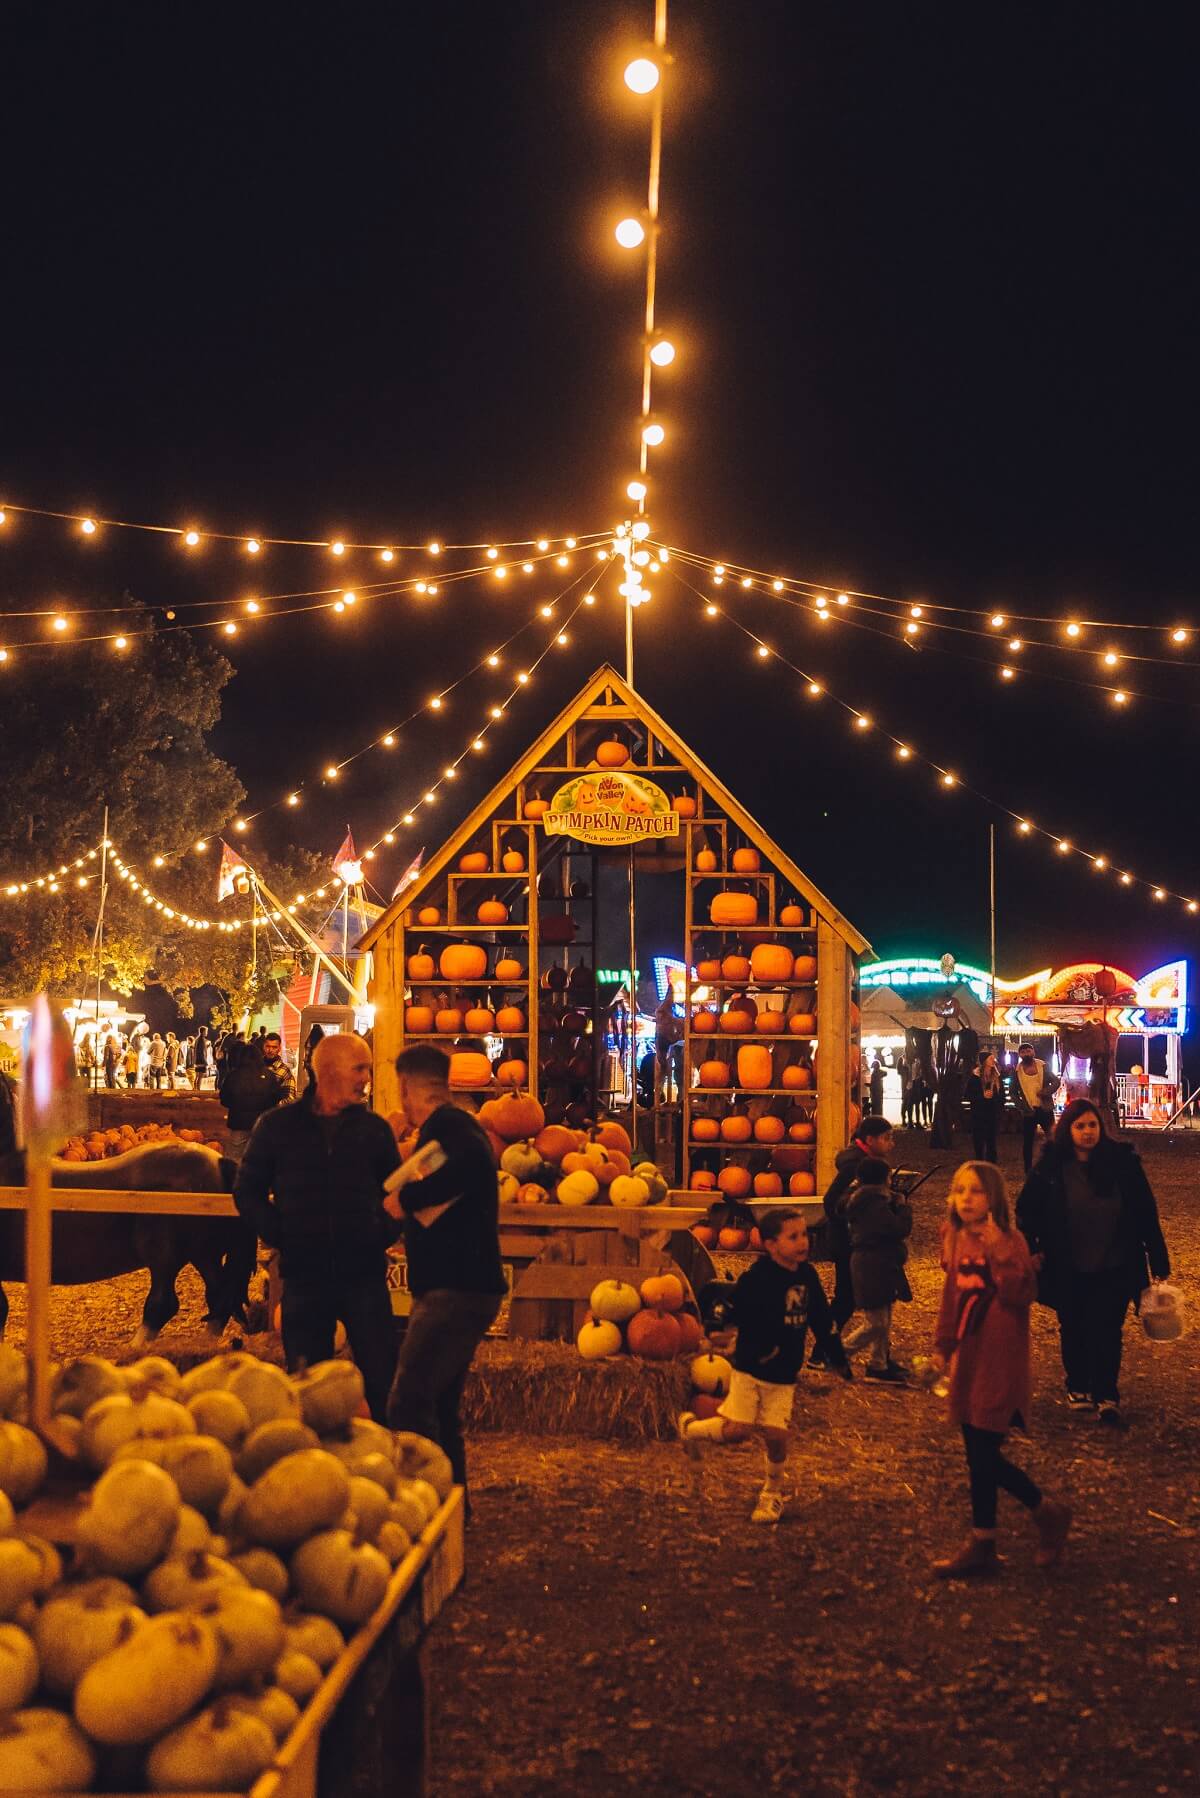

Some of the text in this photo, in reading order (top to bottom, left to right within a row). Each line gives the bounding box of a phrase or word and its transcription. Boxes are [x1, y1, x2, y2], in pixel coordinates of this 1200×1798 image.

[597, 791, 625, 800] Valley
[548, 812, 674, 833] PUMPKIN PATCH
